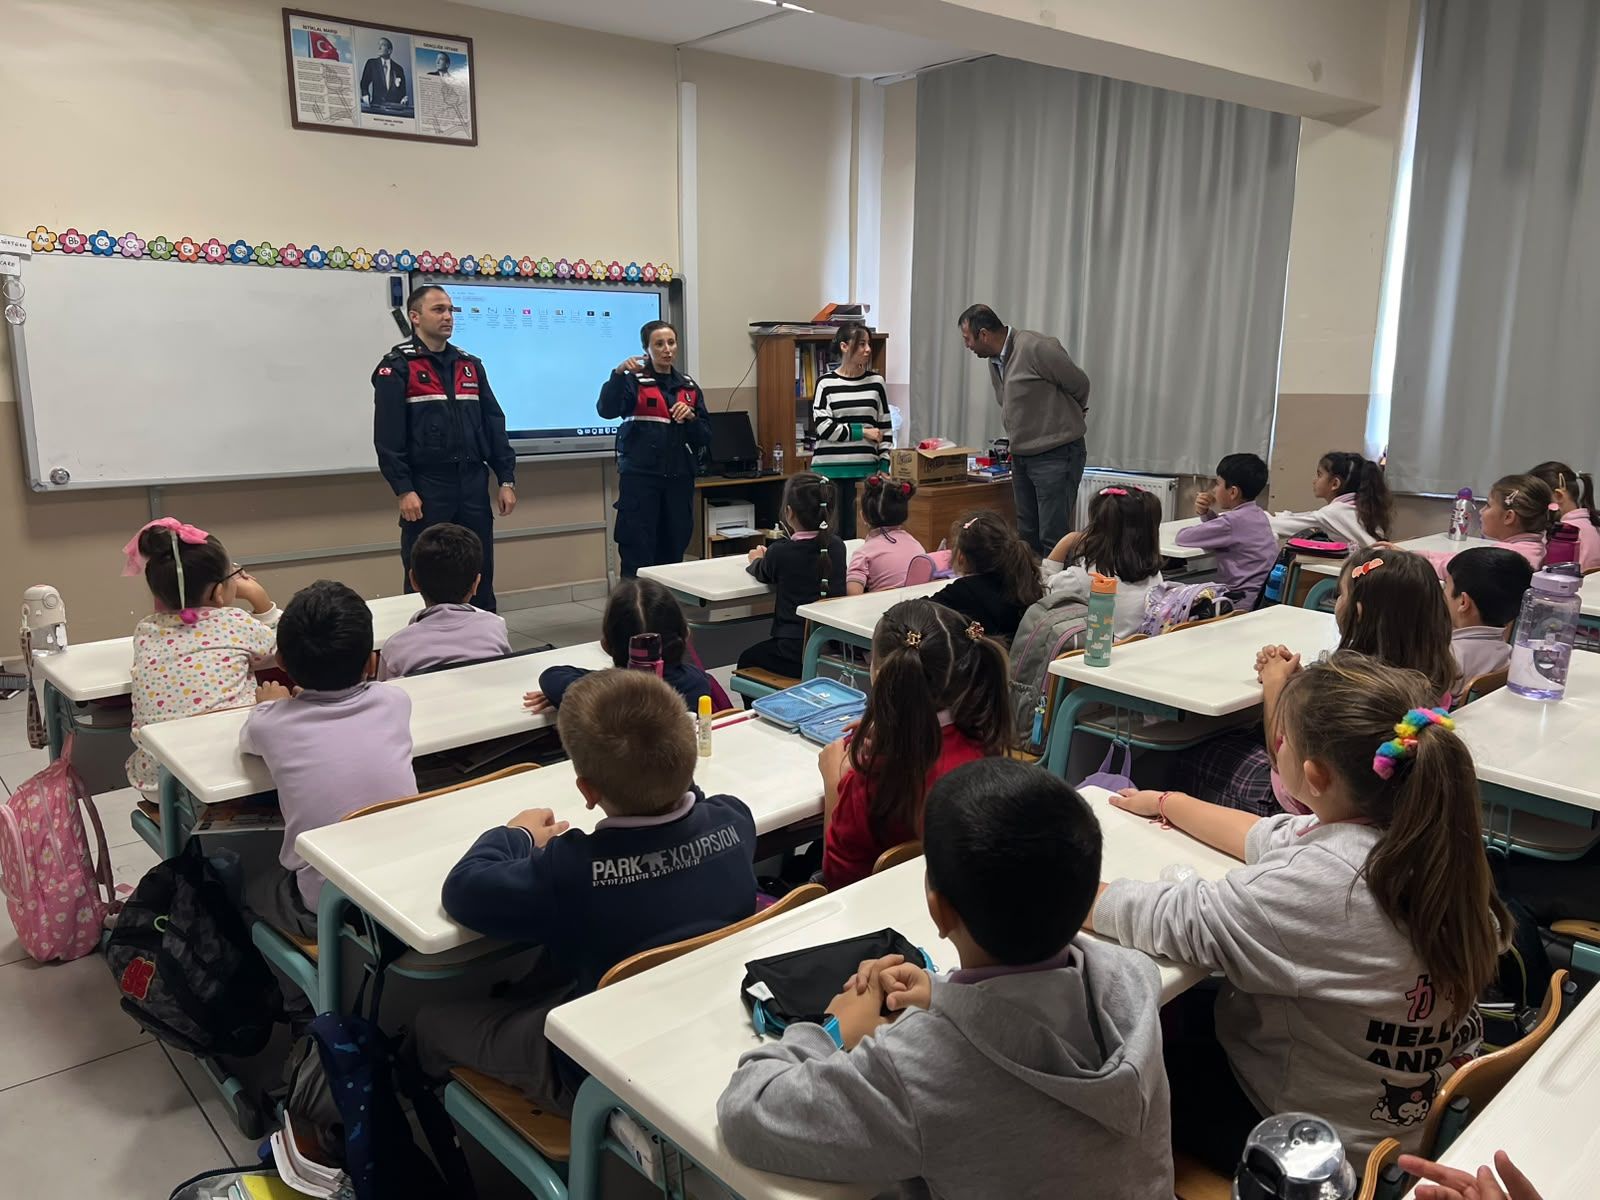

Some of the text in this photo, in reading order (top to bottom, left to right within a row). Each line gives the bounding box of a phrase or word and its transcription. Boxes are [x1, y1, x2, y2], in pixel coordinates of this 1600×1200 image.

[37, 234, 49, 242] Aa
[68, 236, 79, 244] Bb
[97, 238, 108, 246] Cc
[156, 243, 166, 252] Dd
[183, 245, 192, 254] Ee
[592, 824, 740, 880] PARK EXCURSION
[1366, 1047, 1443, 1073] AND
